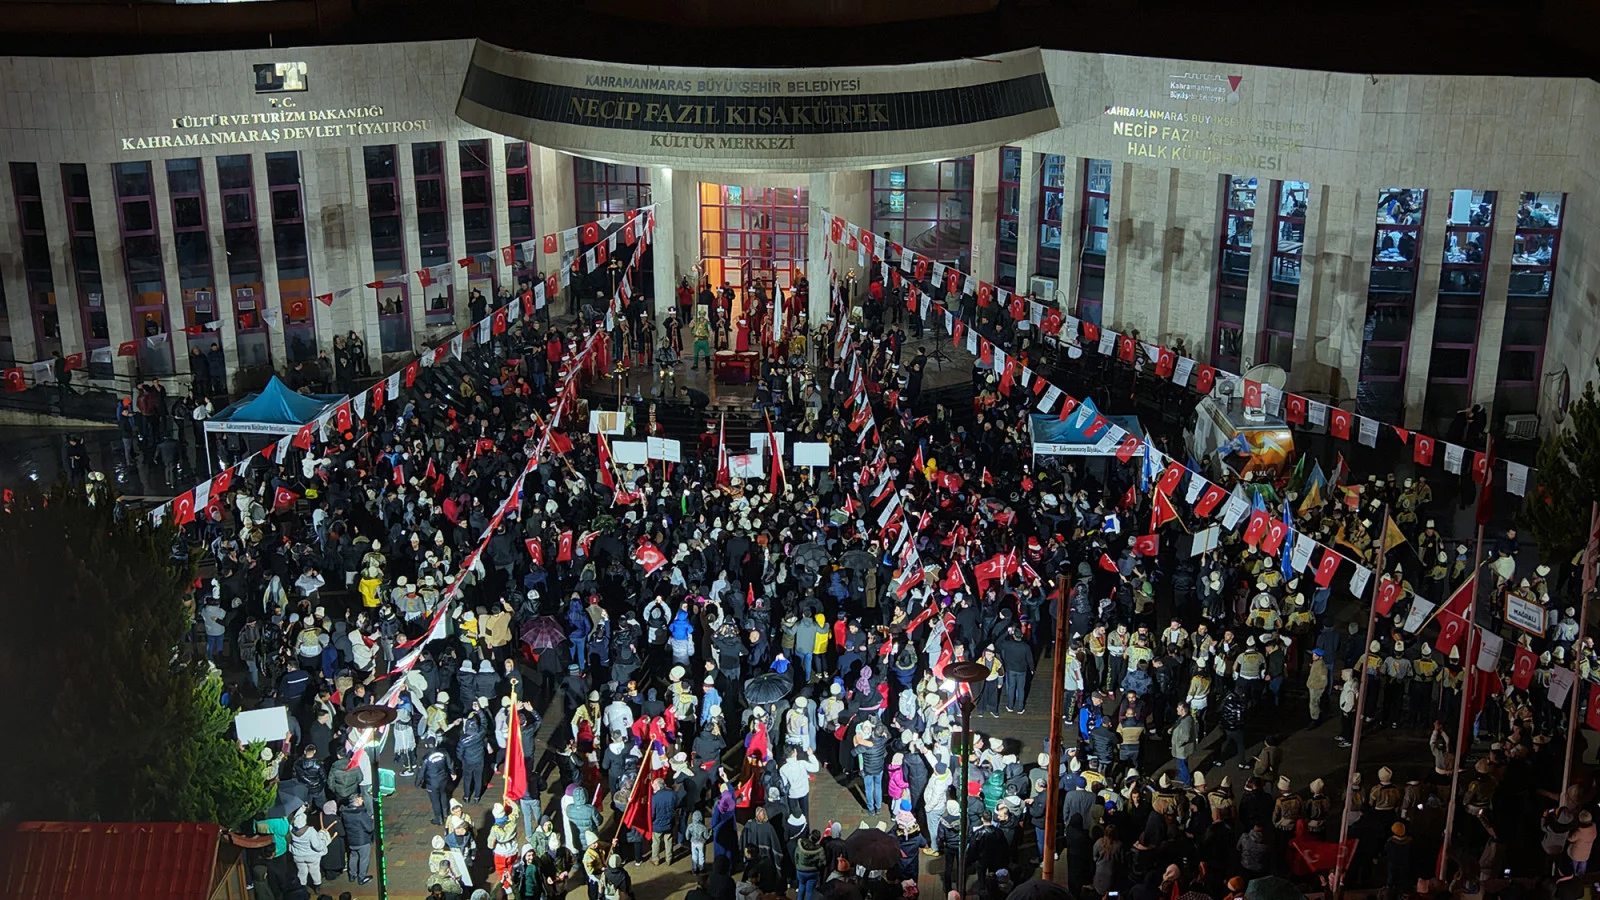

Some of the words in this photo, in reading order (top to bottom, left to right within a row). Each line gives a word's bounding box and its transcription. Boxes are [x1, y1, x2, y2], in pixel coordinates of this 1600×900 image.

[585, 74, 692, 92] KAHRAMANMARAŞ
[697, 77, 781, 93] BÜYÜKŞEHİR
[788, 76, 860, 92] BELEDİYESİ
[268, 97, 296, 108] T.C.
[568, 97, 641, 121] NECİP
[643, 103, 720, 125] FAZIL
[726, 101, 889, 126] KISAKÜREK
[172, 114, 229, 129] KÜLTÜR
[231, 114, 250, 125] VE
[251, 110, 306, 124] TURİZM
[308, 105, 384, 121] BAKANLIĞI
[122, 127, 280, 151] KAHRAMANMARAŞ
[283, 124, 342, 140] DEVLET
[346, 120, 432, 136] TİYATROSU
[1113, 120, 1158, 138] NECİP
[650, 134, 715, 150] KÜLTÜR
[718, 135, 796, 150] MERKEZİ
[1128, 142, 1167, 159] HALK
